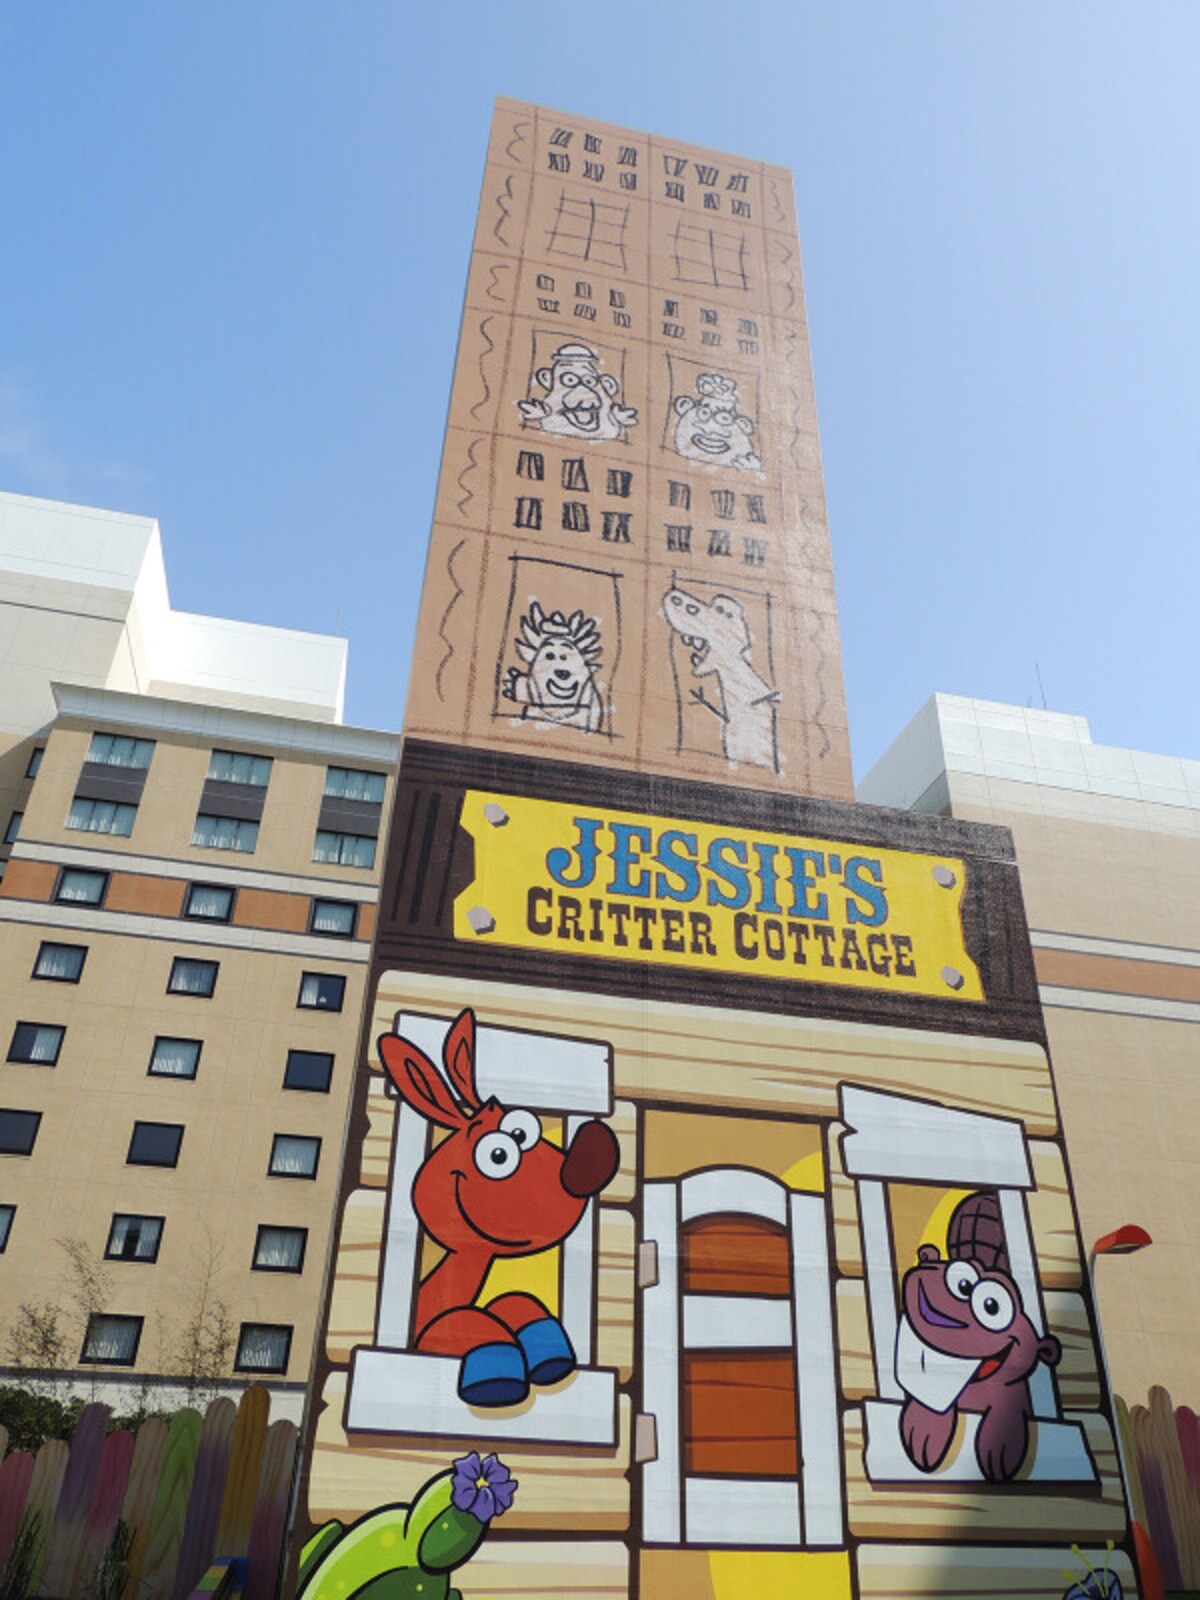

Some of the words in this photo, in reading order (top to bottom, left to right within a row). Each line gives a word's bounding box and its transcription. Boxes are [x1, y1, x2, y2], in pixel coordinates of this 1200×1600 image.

[546, 817, 889, 927] JESSIE'S
[526, 886, 717, 956] CRITTER
[733, 911, 917, 978] COTTAGE
